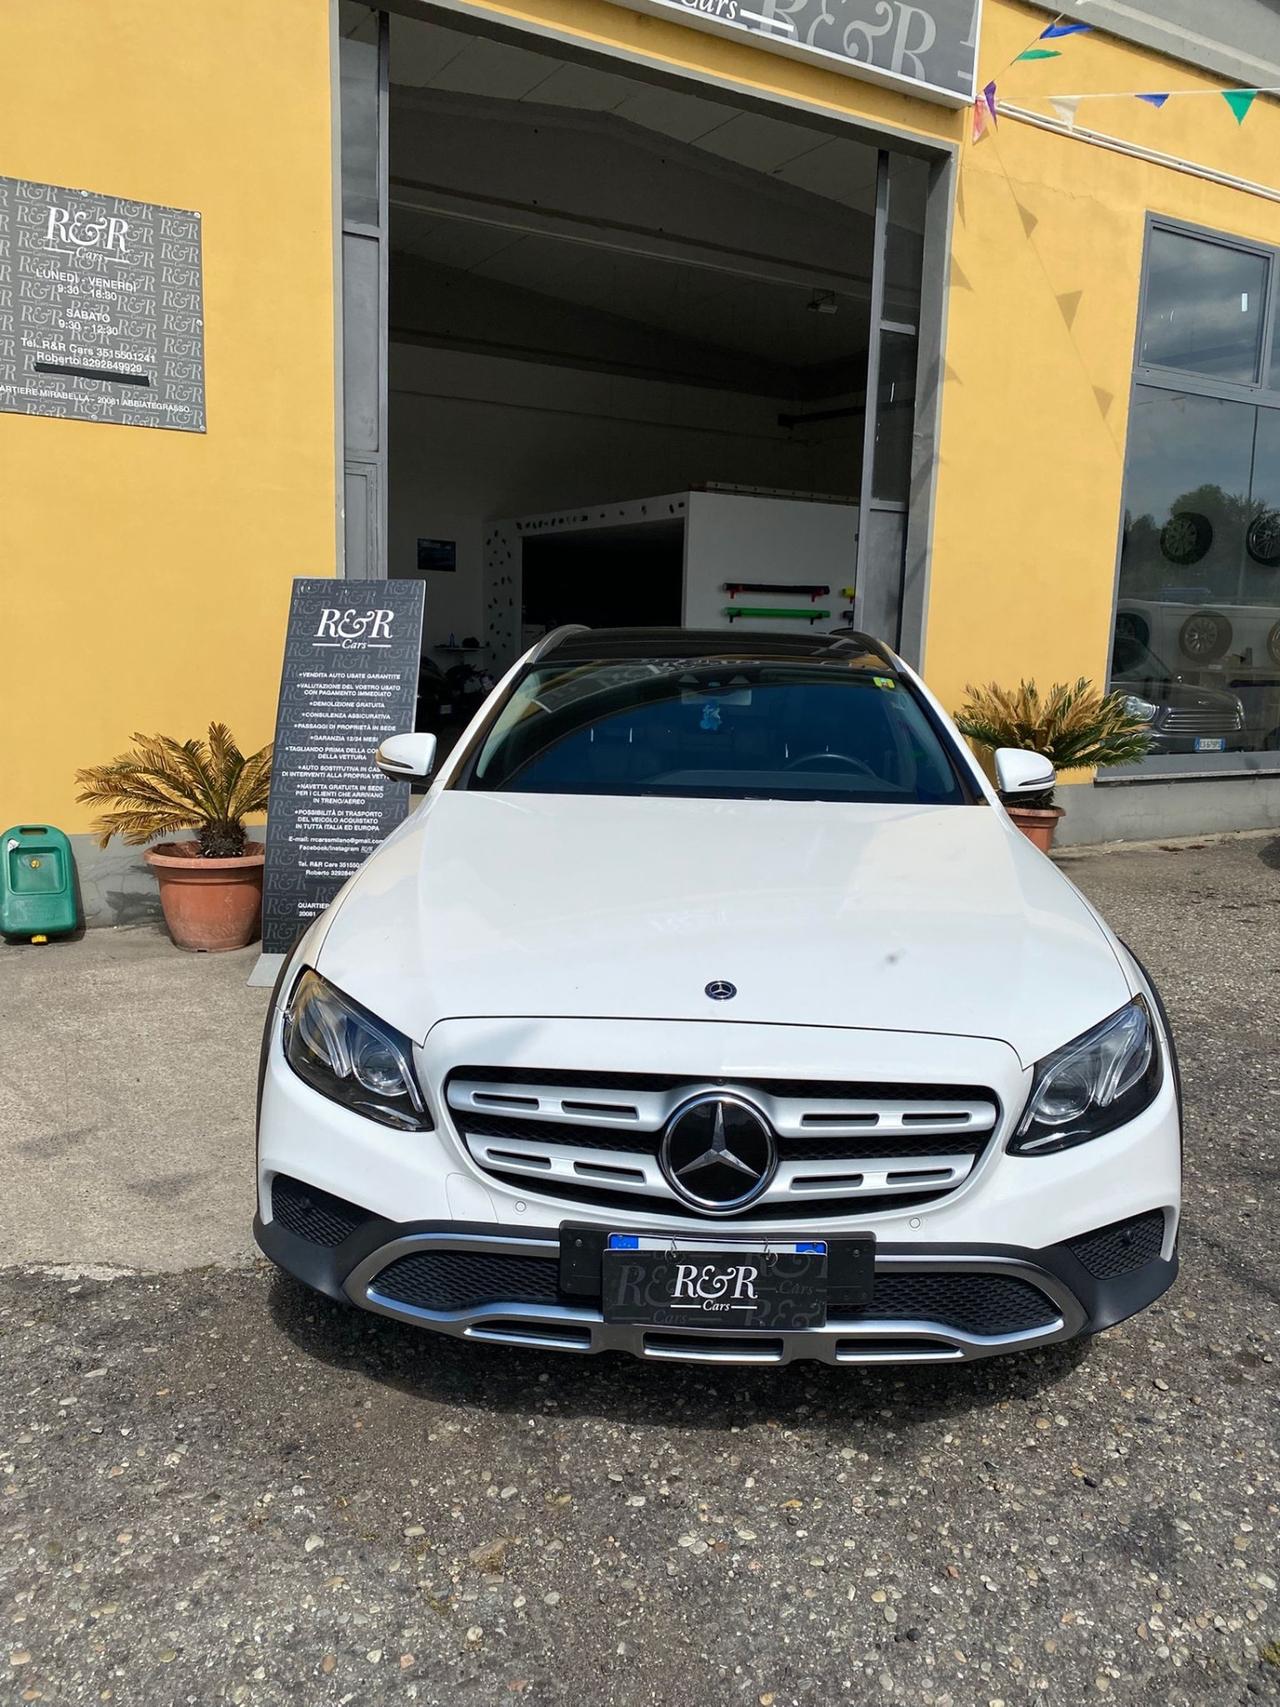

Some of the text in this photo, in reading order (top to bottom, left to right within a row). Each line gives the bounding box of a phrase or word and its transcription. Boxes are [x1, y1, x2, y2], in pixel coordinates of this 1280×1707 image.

[679, 0, 738, 20] ars
[43, 205, 131, 252] R&R
[76, 246, 104, 261] Cars
[57, 283, 80, 295] 9:30
[66, 308, 111, 324] SABATO
[58, 318, 81, 331] 9:30
[91, 323, 119, 336] 12:30
[42, 340, 67, 352] R&R
[69, 343, 94, 356] Cars
[36, 351, 79, 365] Roberto
[39, 390, 90, 402] MIRABELLA
[121, 399, 190, 413] ABBIATEGRASSO
[313, 608, 395, 638] R&R
[341, 639, 368, 649] Cars
[298, 844, 360, 852] Facebook/Instagram
[670, 1264, 759, 1299] R&R
[702, 1299, 731, 1311] Cars
